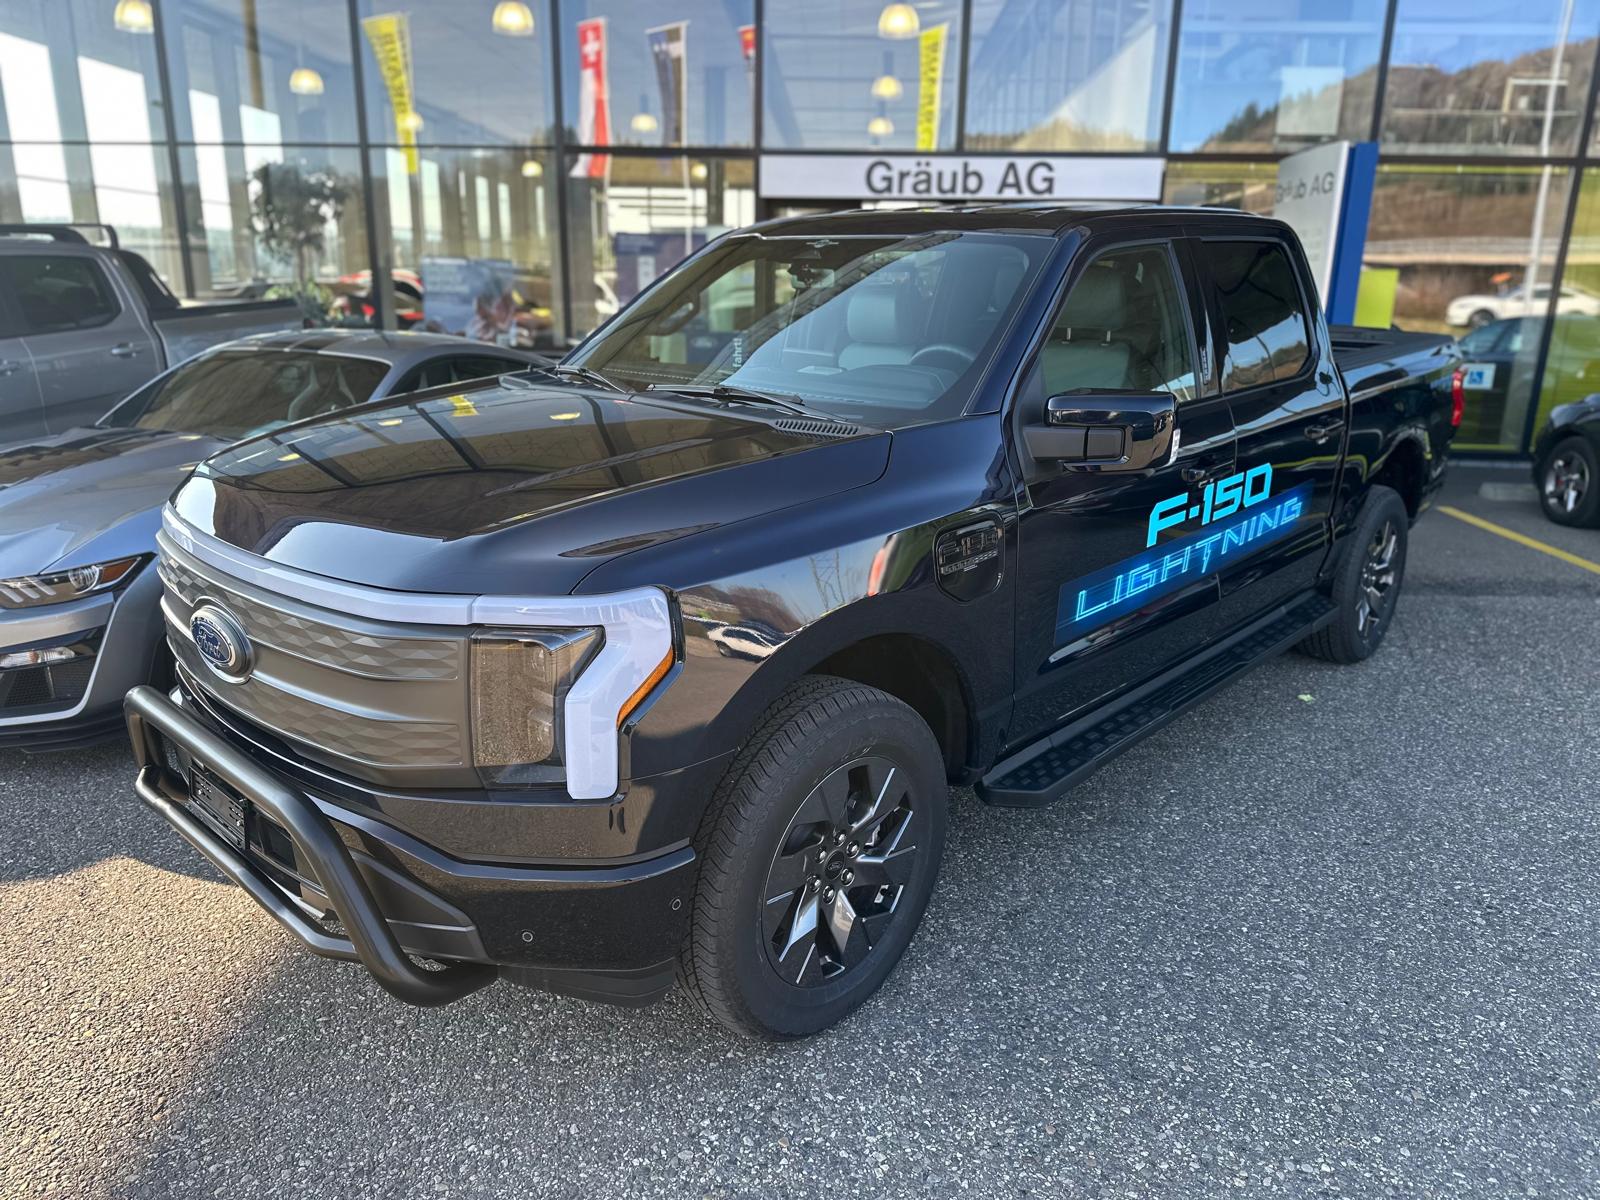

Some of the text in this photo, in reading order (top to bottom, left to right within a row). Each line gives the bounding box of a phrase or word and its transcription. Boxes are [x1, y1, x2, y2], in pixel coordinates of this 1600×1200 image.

[866, 160, 1055, 195] Gräub AG
[1309, 171, 1335, 196] AG
[1146, 462, 1273, 548] F-150
[1076, 497, 1302, 621] LIGHTNING
